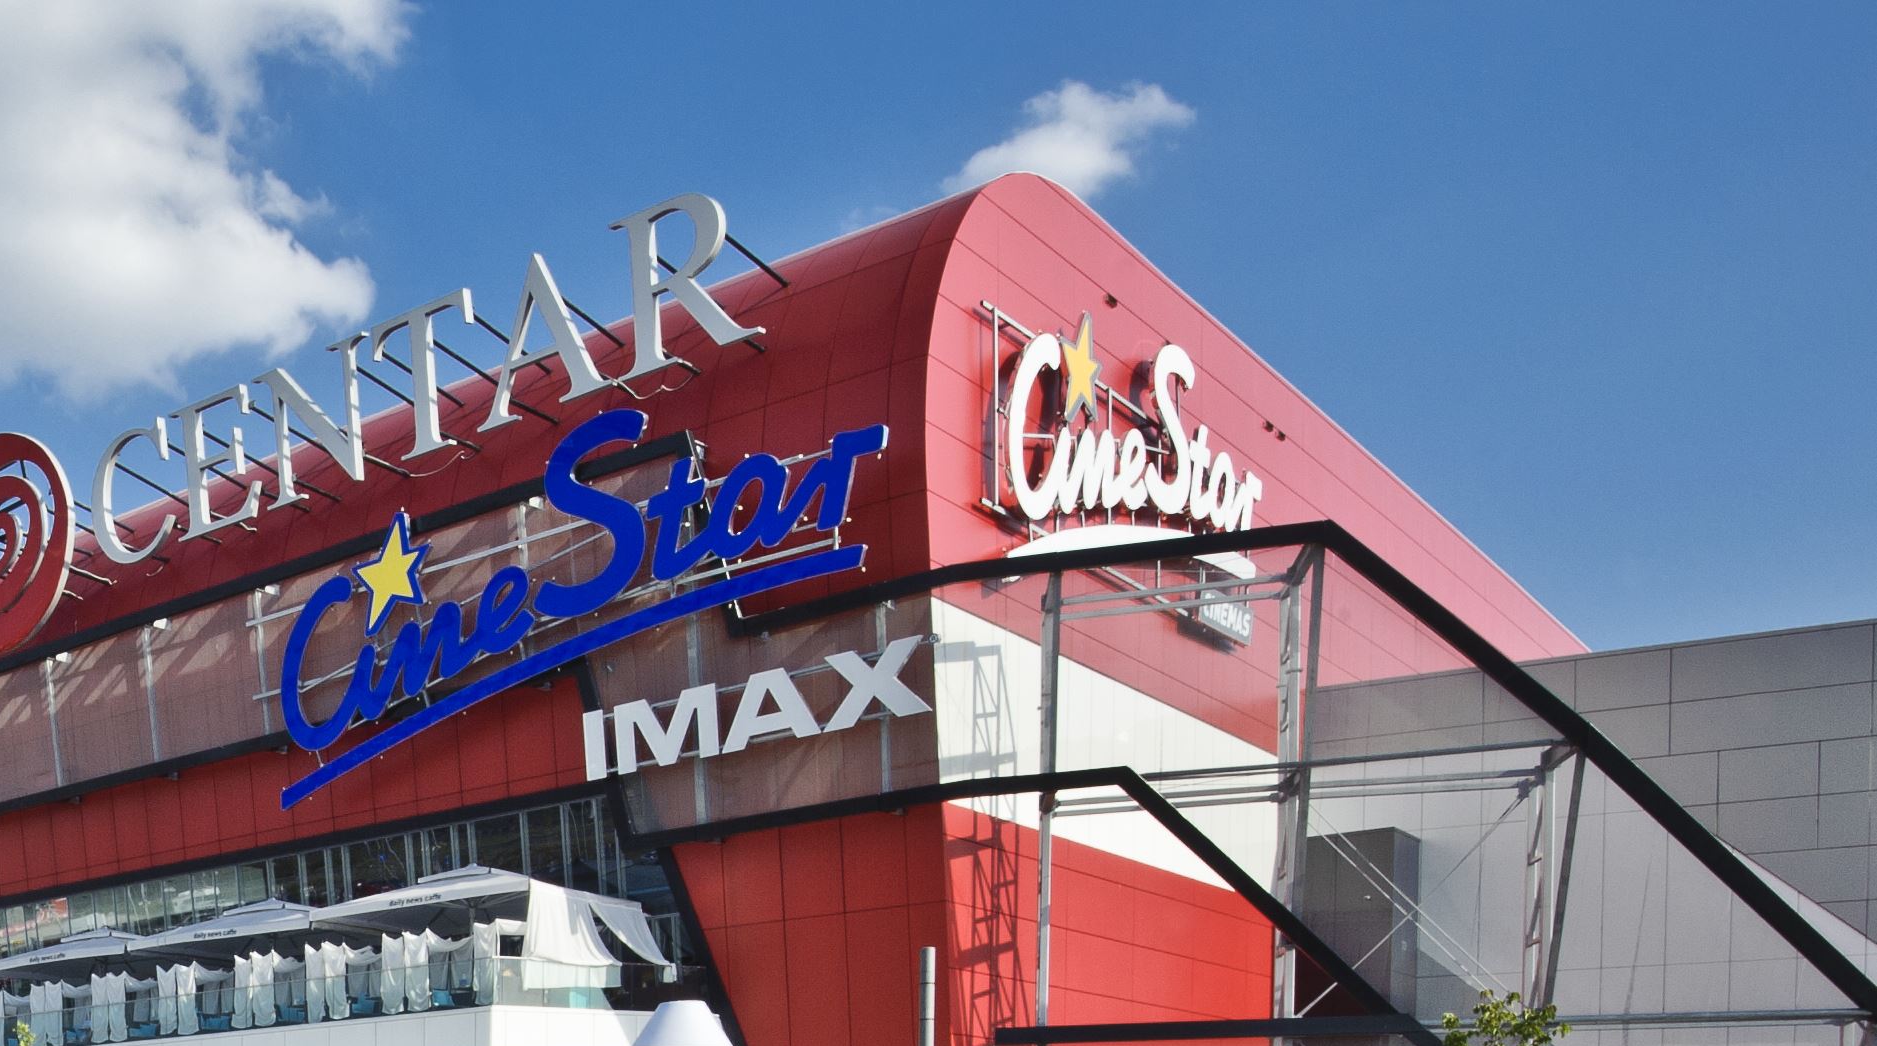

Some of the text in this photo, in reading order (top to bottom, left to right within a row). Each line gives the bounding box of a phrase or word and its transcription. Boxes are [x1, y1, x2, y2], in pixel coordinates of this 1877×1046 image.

[91, 192, 767, 565] CENTAR
[1008, 312, 1262, 532] CineStar
[281, 409, 889, 752] CineStar
[583, 634, 933, 782] IMAX
